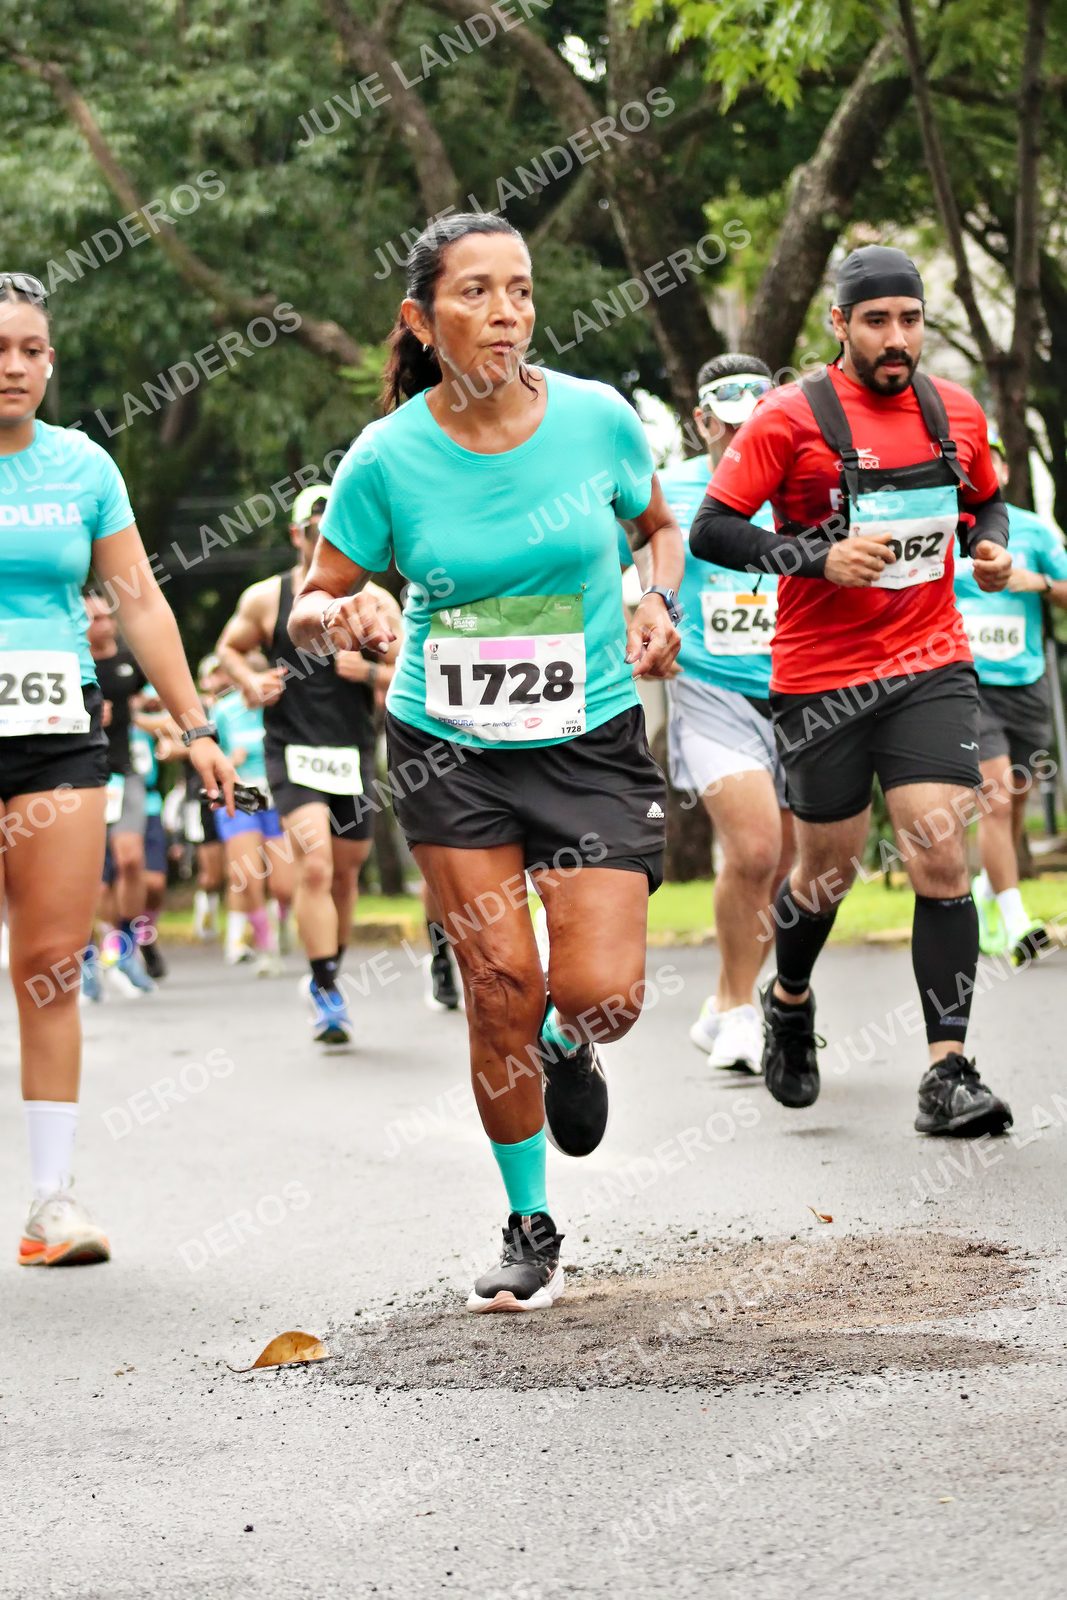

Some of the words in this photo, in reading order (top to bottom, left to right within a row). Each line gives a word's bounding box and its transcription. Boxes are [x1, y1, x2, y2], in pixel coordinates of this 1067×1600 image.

[711, 608, 778, 632] 624
[440, 661, 574, 706] 1728
[561, 725, 582, 735] 1728
